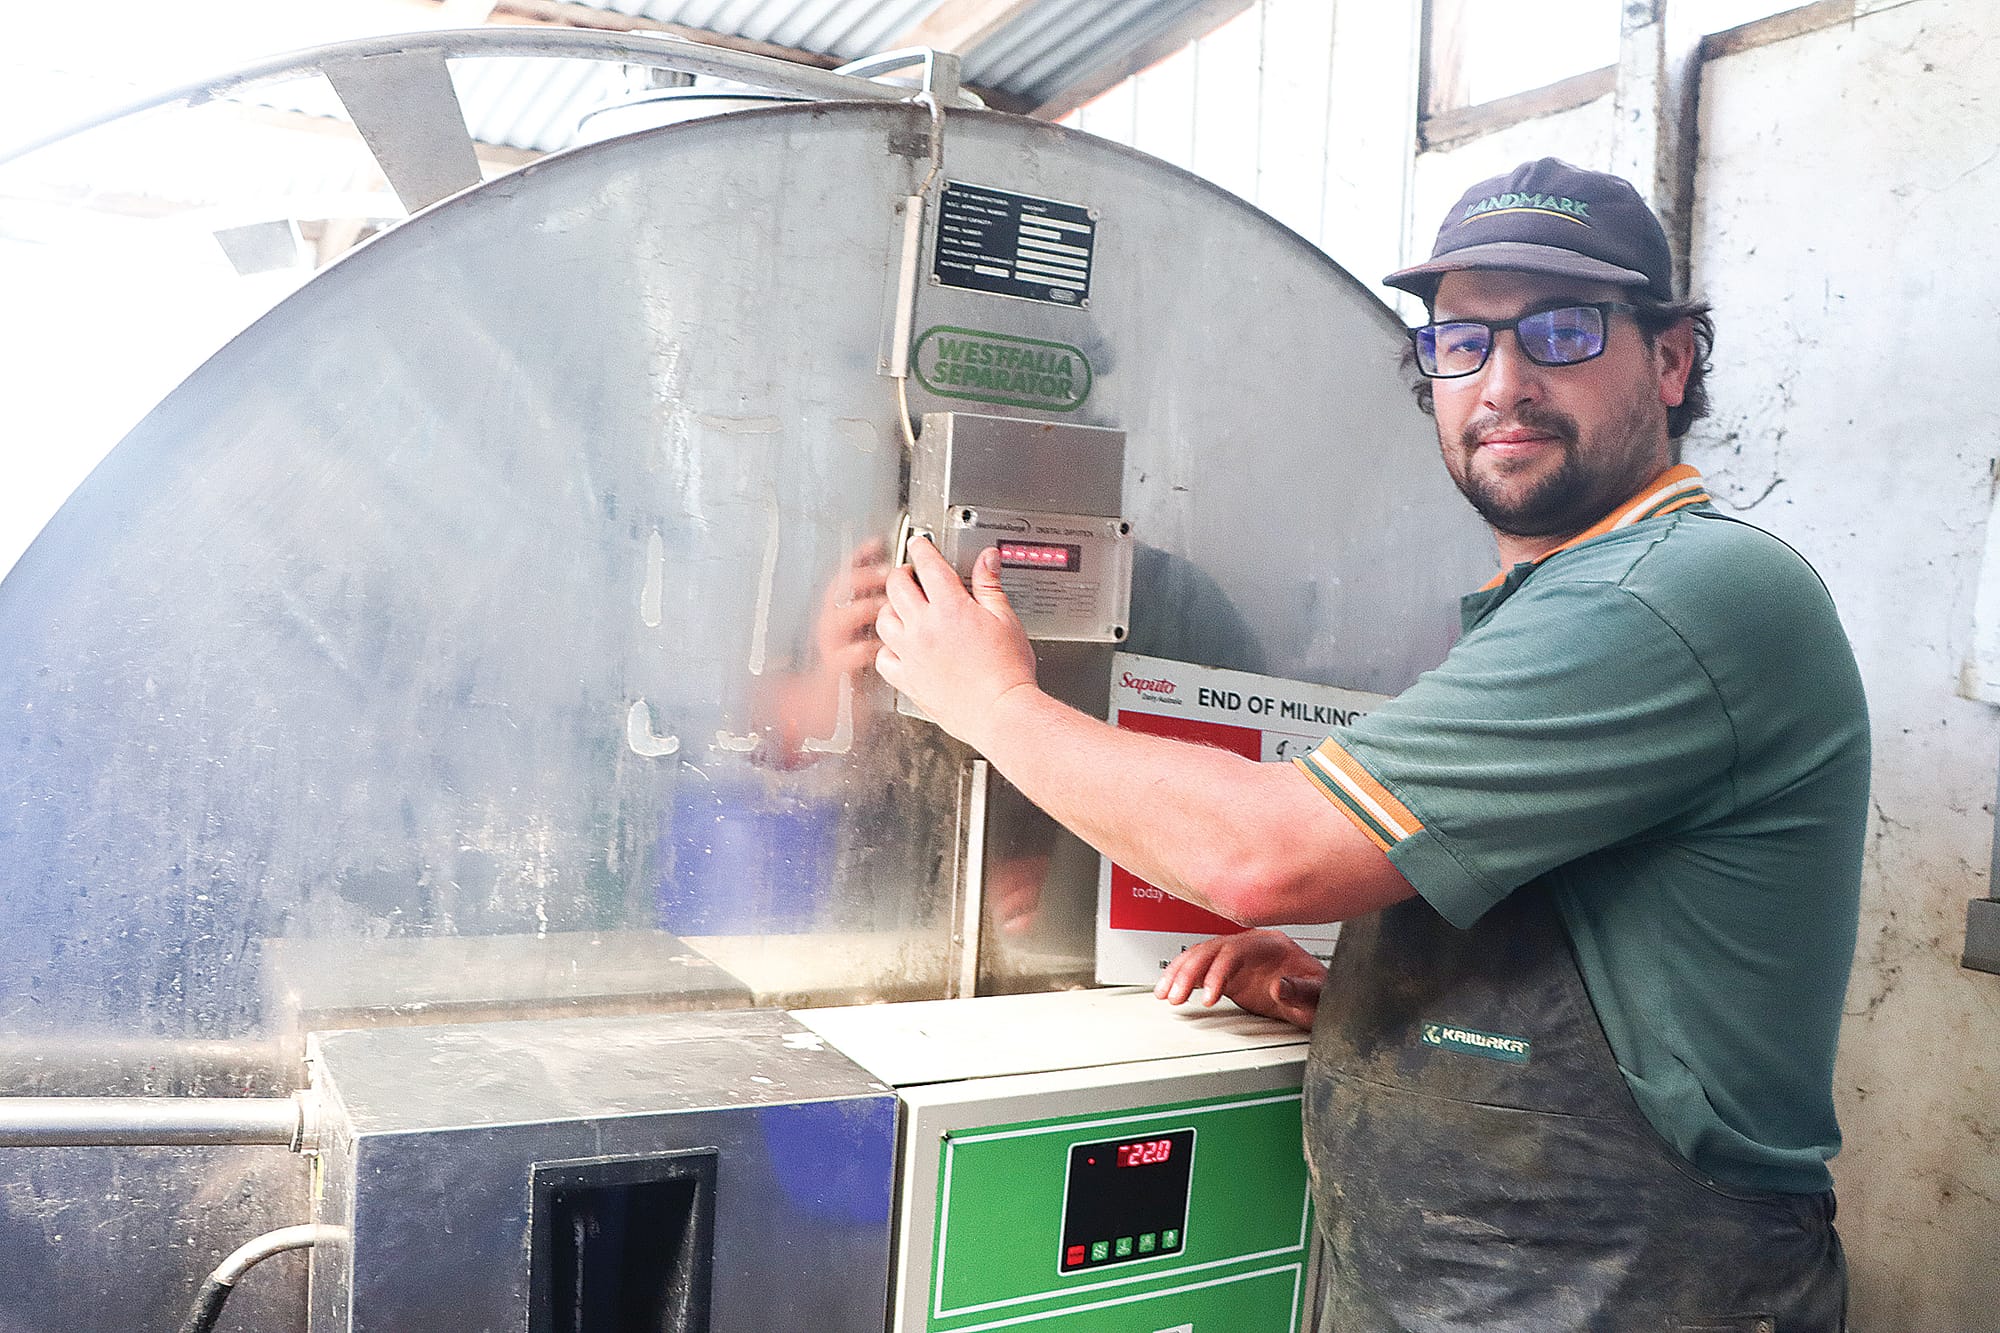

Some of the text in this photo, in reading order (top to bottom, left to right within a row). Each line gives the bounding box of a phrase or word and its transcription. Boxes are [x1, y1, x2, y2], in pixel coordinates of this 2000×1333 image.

[1462, 191, 1591, 219] LANDMARK
[937, 337, 1073, 378] WESTFALIA
[932, 361, 1074, 400] SEPARATOR
[1119, 671, 1177, 695] Saputo
[1198, 687, 1242, 711] END
[1247, 696, 1275, 716] OF
[1132, 885, 1164, 903] today
[1442, 1027, 1525, 1054] KAIWAKA
